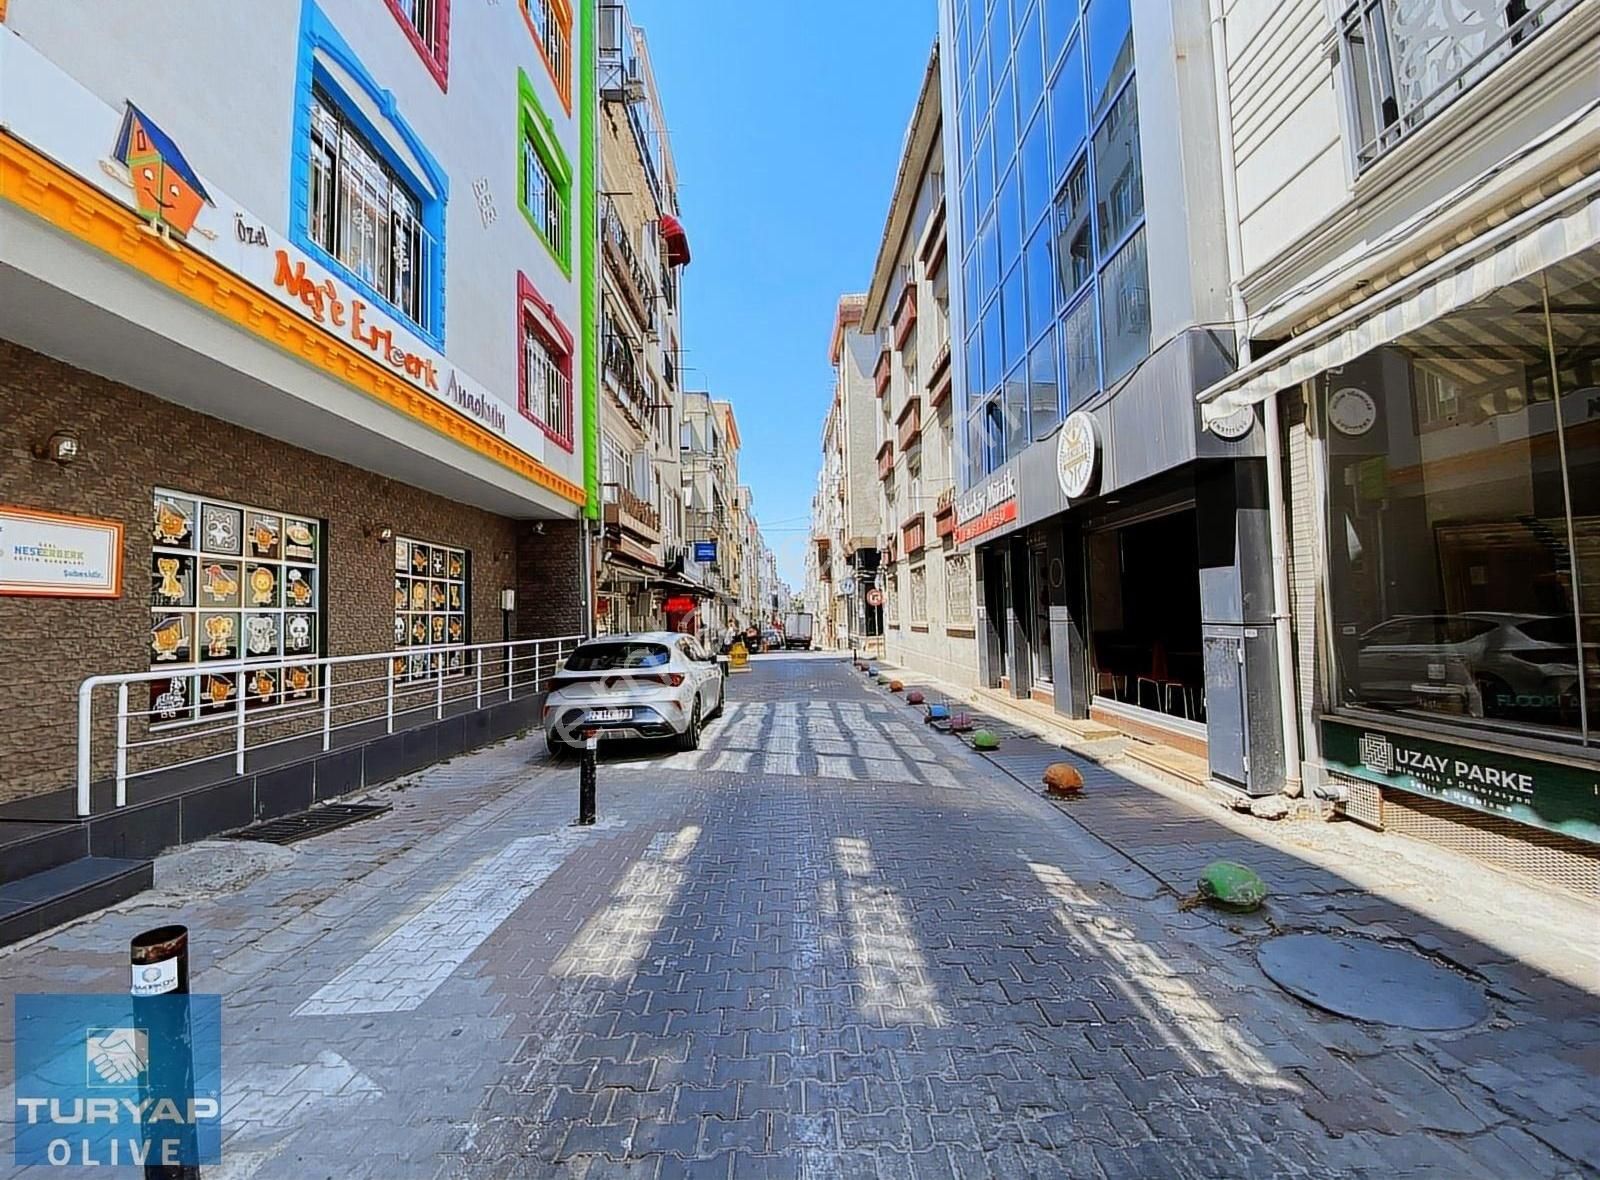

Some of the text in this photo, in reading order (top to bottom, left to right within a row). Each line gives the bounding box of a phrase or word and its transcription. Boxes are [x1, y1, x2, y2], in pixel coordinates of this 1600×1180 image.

[233, 211, 269, 248] Özel
[1395, 747, 1534, 794] UZAY PARKE
[1458, 781, 1532, 806] Dekorasyon
